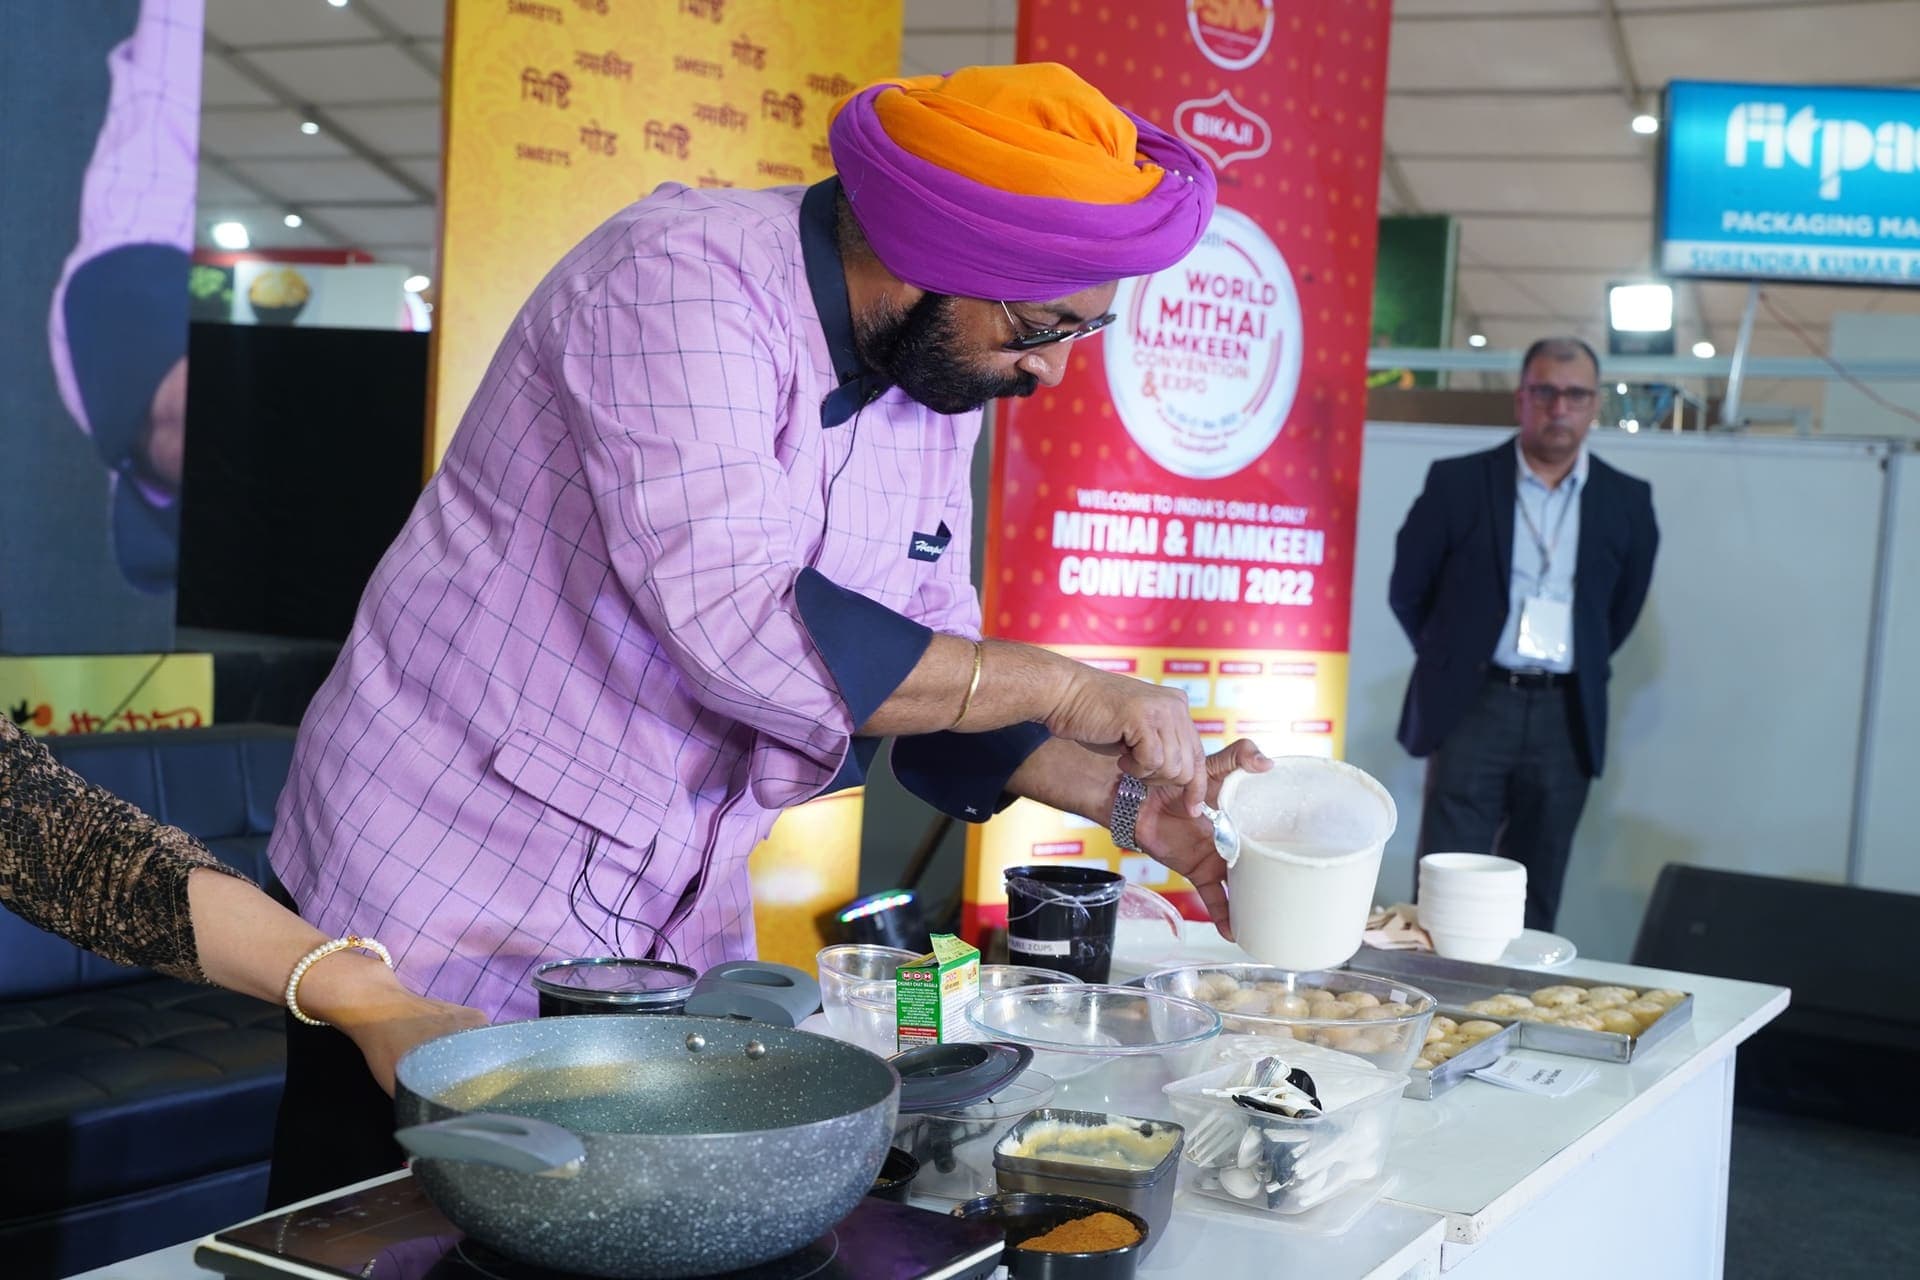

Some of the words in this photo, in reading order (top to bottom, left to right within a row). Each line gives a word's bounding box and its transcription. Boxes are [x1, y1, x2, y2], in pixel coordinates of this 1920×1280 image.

[1192, 112, 1254, 146] BIKAJI
[1721, 211, 1874, 238] PACKAGING
[1185, 269, 1278, 306] WORLD
[1160, 296, 1267, 339] MITHAI
[1134, 328, 1249, 361] NAMKEEN
[1133, 351, 1250, 380] CONVENTION
[1076, 488, 1150, 514] WELCOME
[1153, 494, 1172, 514] TO
[1173, 497, 1225, 519] INDIA'S
[1226, 500, 1256, 521] ONE
[1270, 504, 1309, 525] ONLY
[1052, 511, 1158, 555] MITHAI
[1163, 519, 1187, 557] &
[1192, 521, 1325, 566] NAMKEEN
[1058, 556, 1241, 602] CONVENTION
[1244, 567, 1314, 606] 2022
